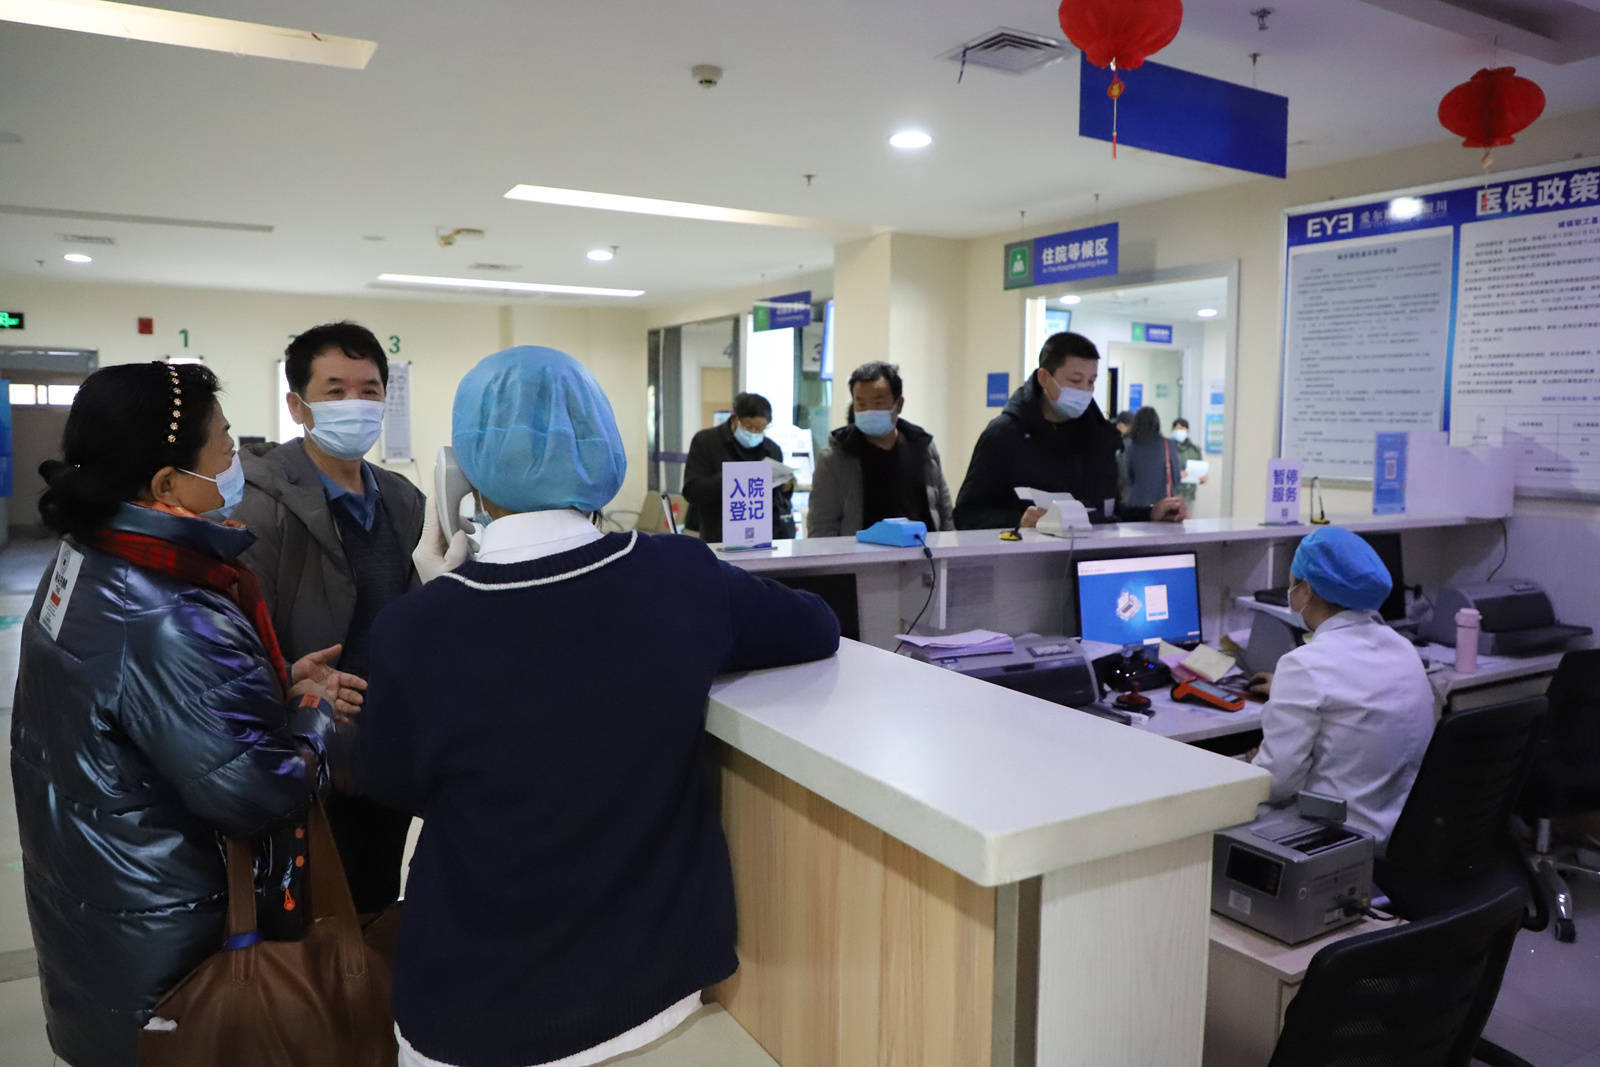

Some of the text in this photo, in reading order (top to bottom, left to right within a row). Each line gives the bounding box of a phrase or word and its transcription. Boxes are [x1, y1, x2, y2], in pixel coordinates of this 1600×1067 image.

[1476, 172, 1600, 217] 医保政策
[1042, 238, 1109, 266] 住院等候区
[179, 329, 188, 348] 1
[388, 335, 401, 354] 3
[730, 477, 765, 498] 入院
[729, 500, 765, 521] 登记
